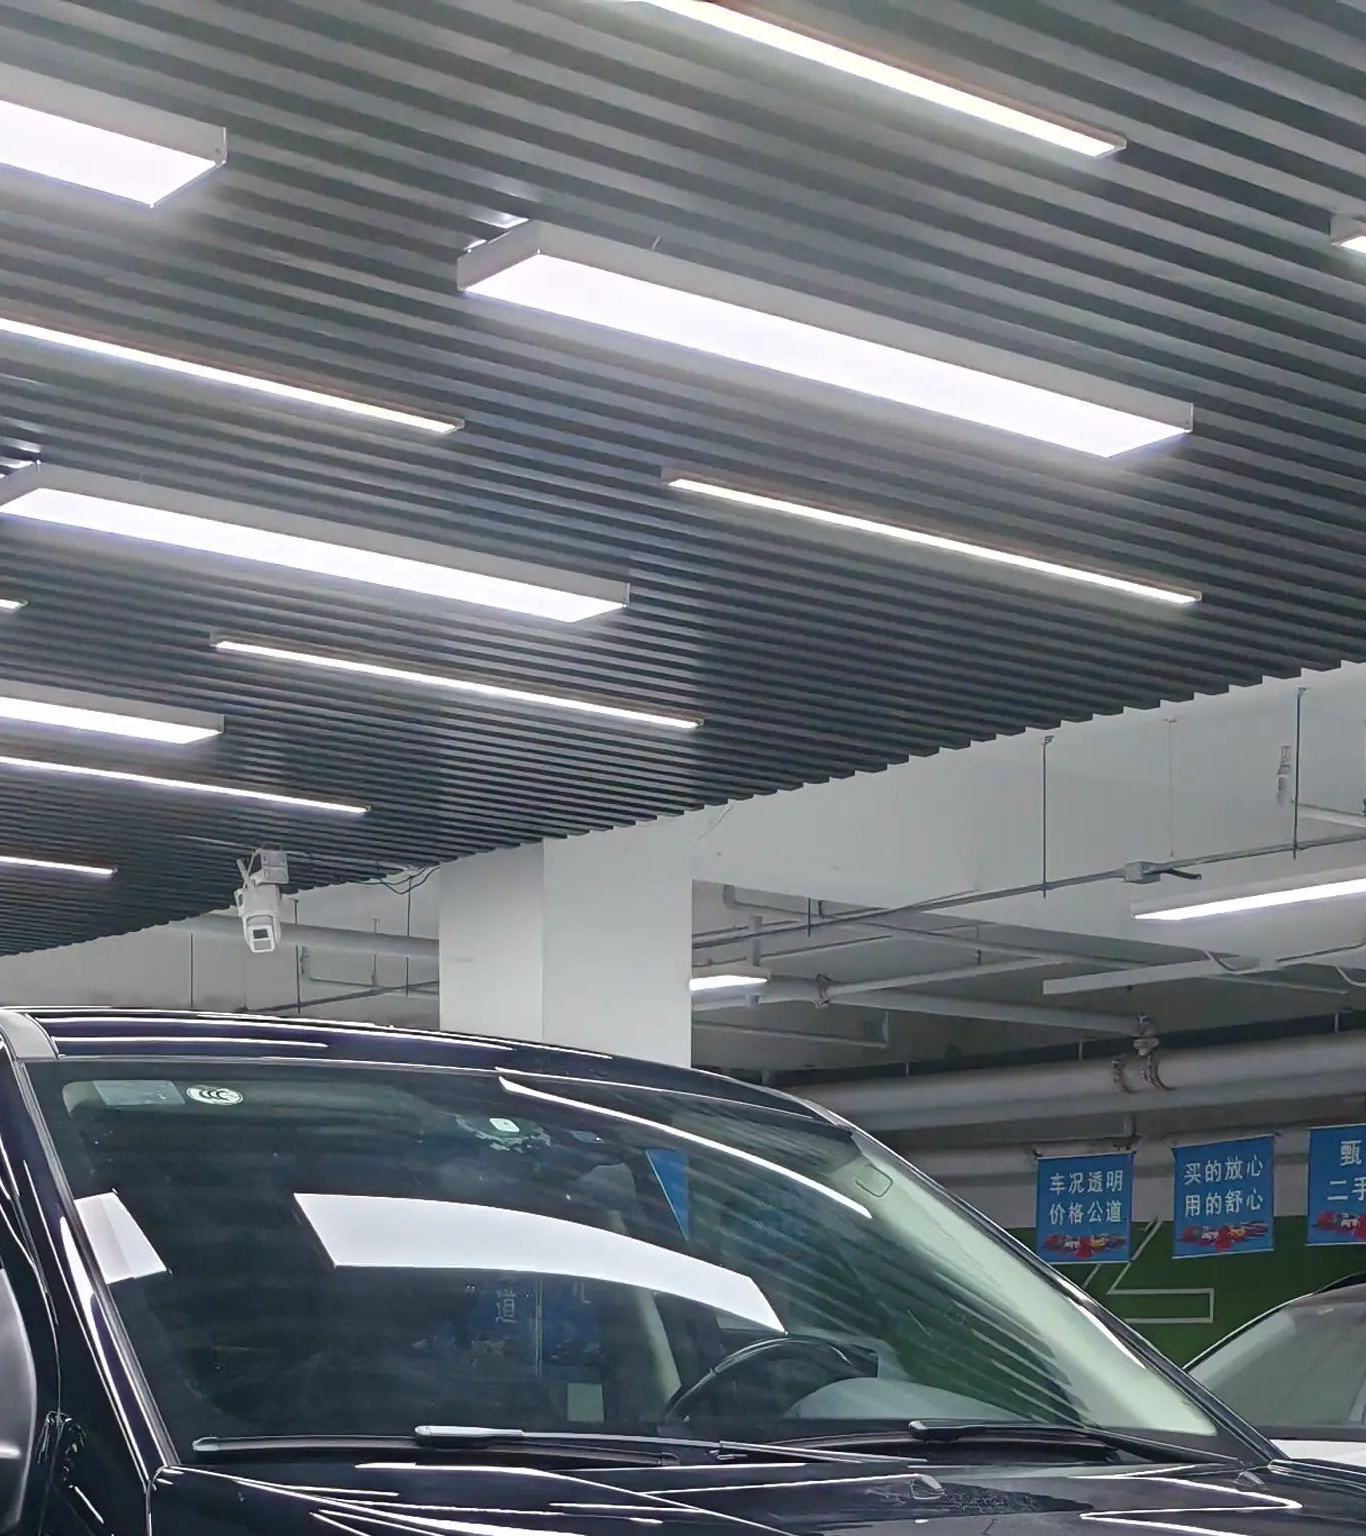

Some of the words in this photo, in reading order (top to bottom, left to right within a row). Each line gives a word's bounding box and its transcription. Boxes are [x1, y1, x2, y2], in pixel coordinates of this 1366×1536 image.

[1049, 1169, 1124, 1196] 车况透明
[1183, 1155, 1264, 1186] 买的放心
[1049, 1199, 1123, 1226] 价格公道
[1183, 1188, 1264, 1218] 用的舒心
